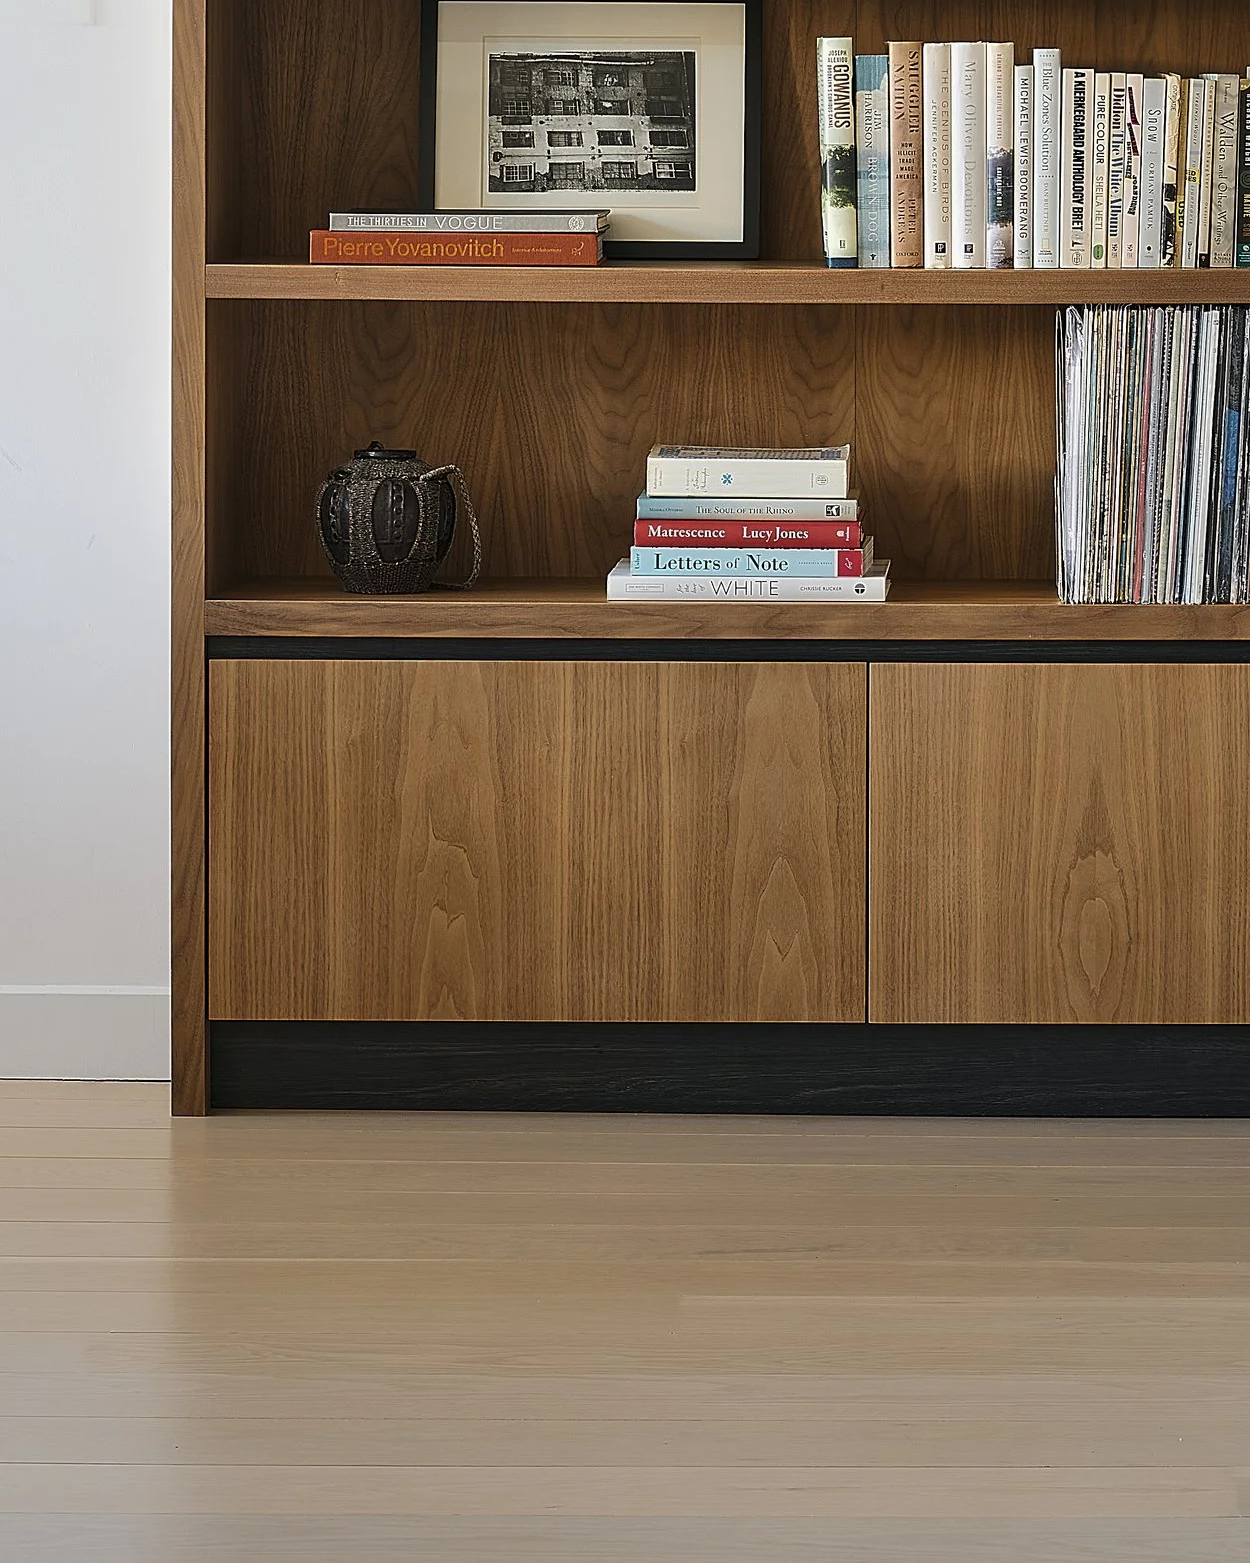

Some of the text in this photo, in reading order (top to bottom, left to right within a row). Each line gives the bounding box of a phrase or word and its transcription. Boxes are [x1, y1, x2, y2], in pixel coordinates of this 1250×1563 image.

[833, 64, 850, 128] GOWANUS
[894, 64, 905, 121] NATION
[908, 51, 919, 133] SMUGGLER
[1041, 68, 1053, 171] Blue Zones Solution
[1073, 81, 1086, 148] KIERKEGAARD
[864, 93, 872, 148] HARRISON
[874, 110, 882, 130] JIM
[1148, 109, 1161, 142] Snow
[942, 158, 949, 174] OF
[1019, 78, 1028, 239] MICHAEL LEWIS BOOMERANG
[1072, 149, 1085, 204] ANTHOLOGY
[1095, 95, 1105, 230] PURE COLOUR SHEILA HETI
[1109, 88, 1124, 237] Didion The White Album
[1215, 112, 1234, 246] Walden and Other Writings
[324, 238, 503, 257] Pierre Yovanovitch
[347, 216, 502, 230] THE THIRTIES IN VOGUE
[648, 526, 725, 538] Matrescence
[742, 526, 808, 542] Lucy Jones
[654, 553, 788, 572] Letters of Note
[710, 580, 778, 596] WHITE
